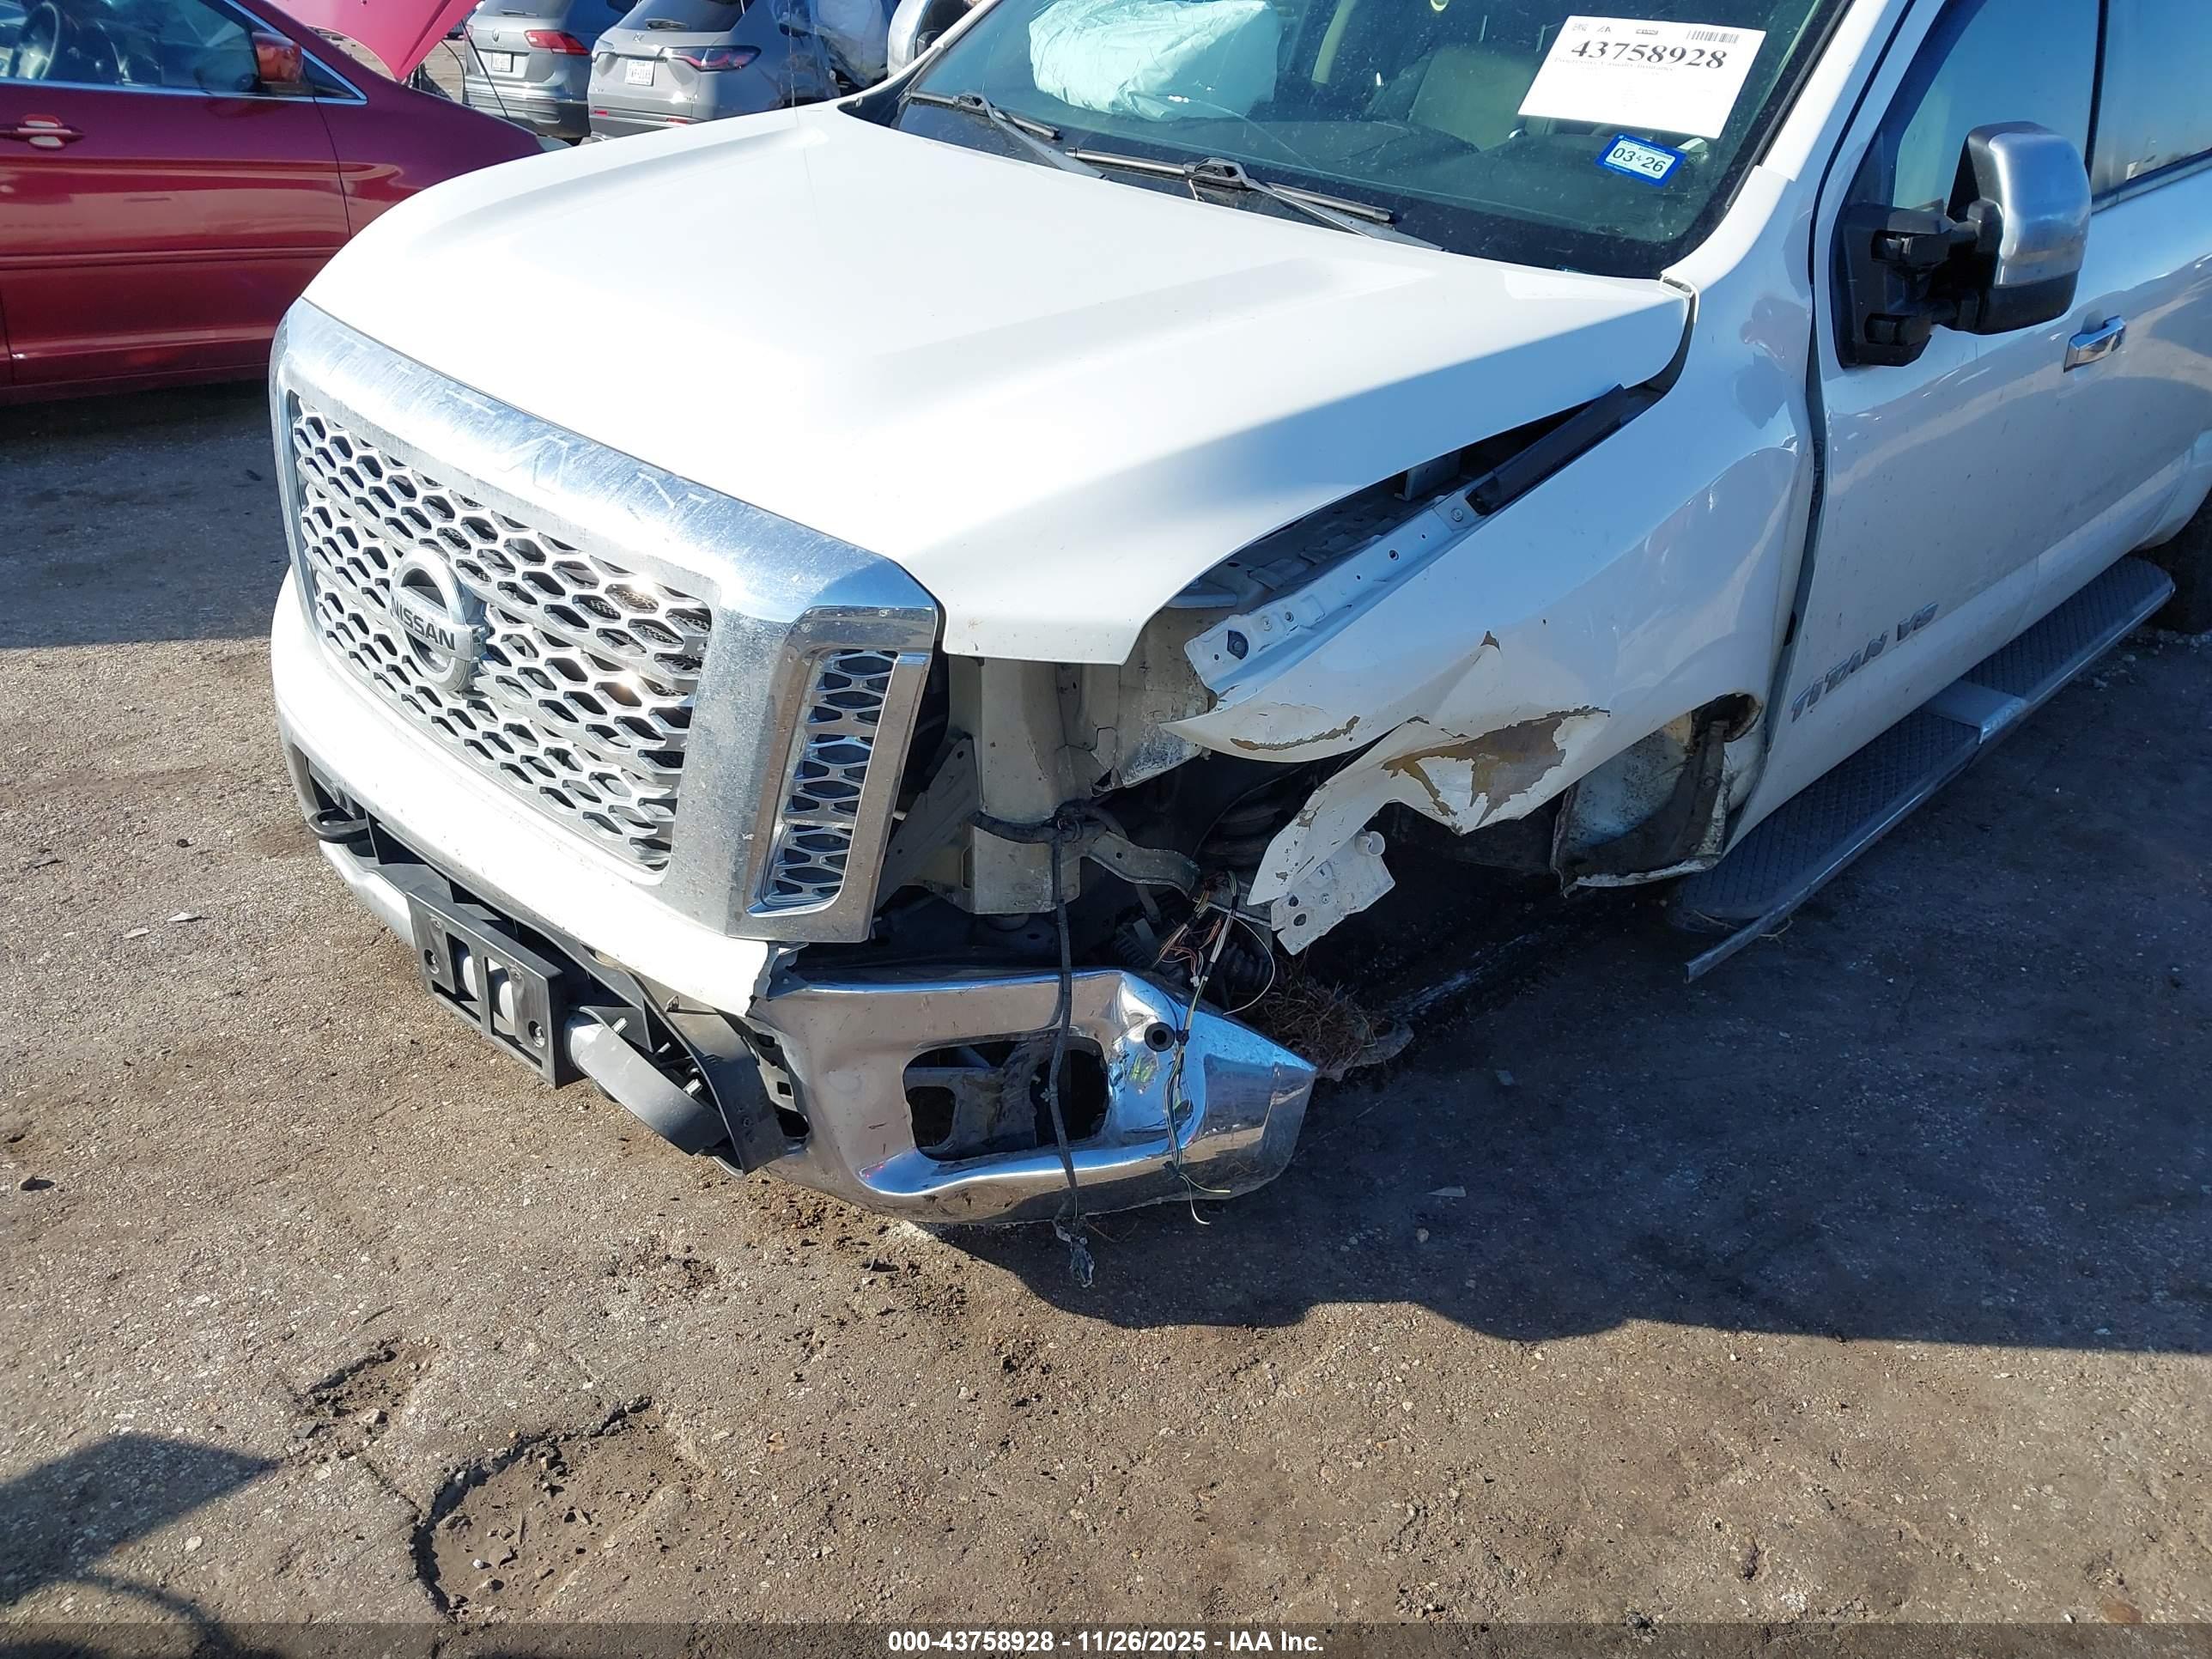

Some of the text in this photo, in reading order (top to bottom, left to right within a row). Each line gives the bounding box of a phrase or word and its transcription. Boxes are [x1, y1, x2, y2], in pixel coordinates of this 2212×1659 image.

[1571, 40, 1728, 70] 43758928
[390, 594, 456, 652] NISSAN
[1791, 629, 1889, 724] TITAN
